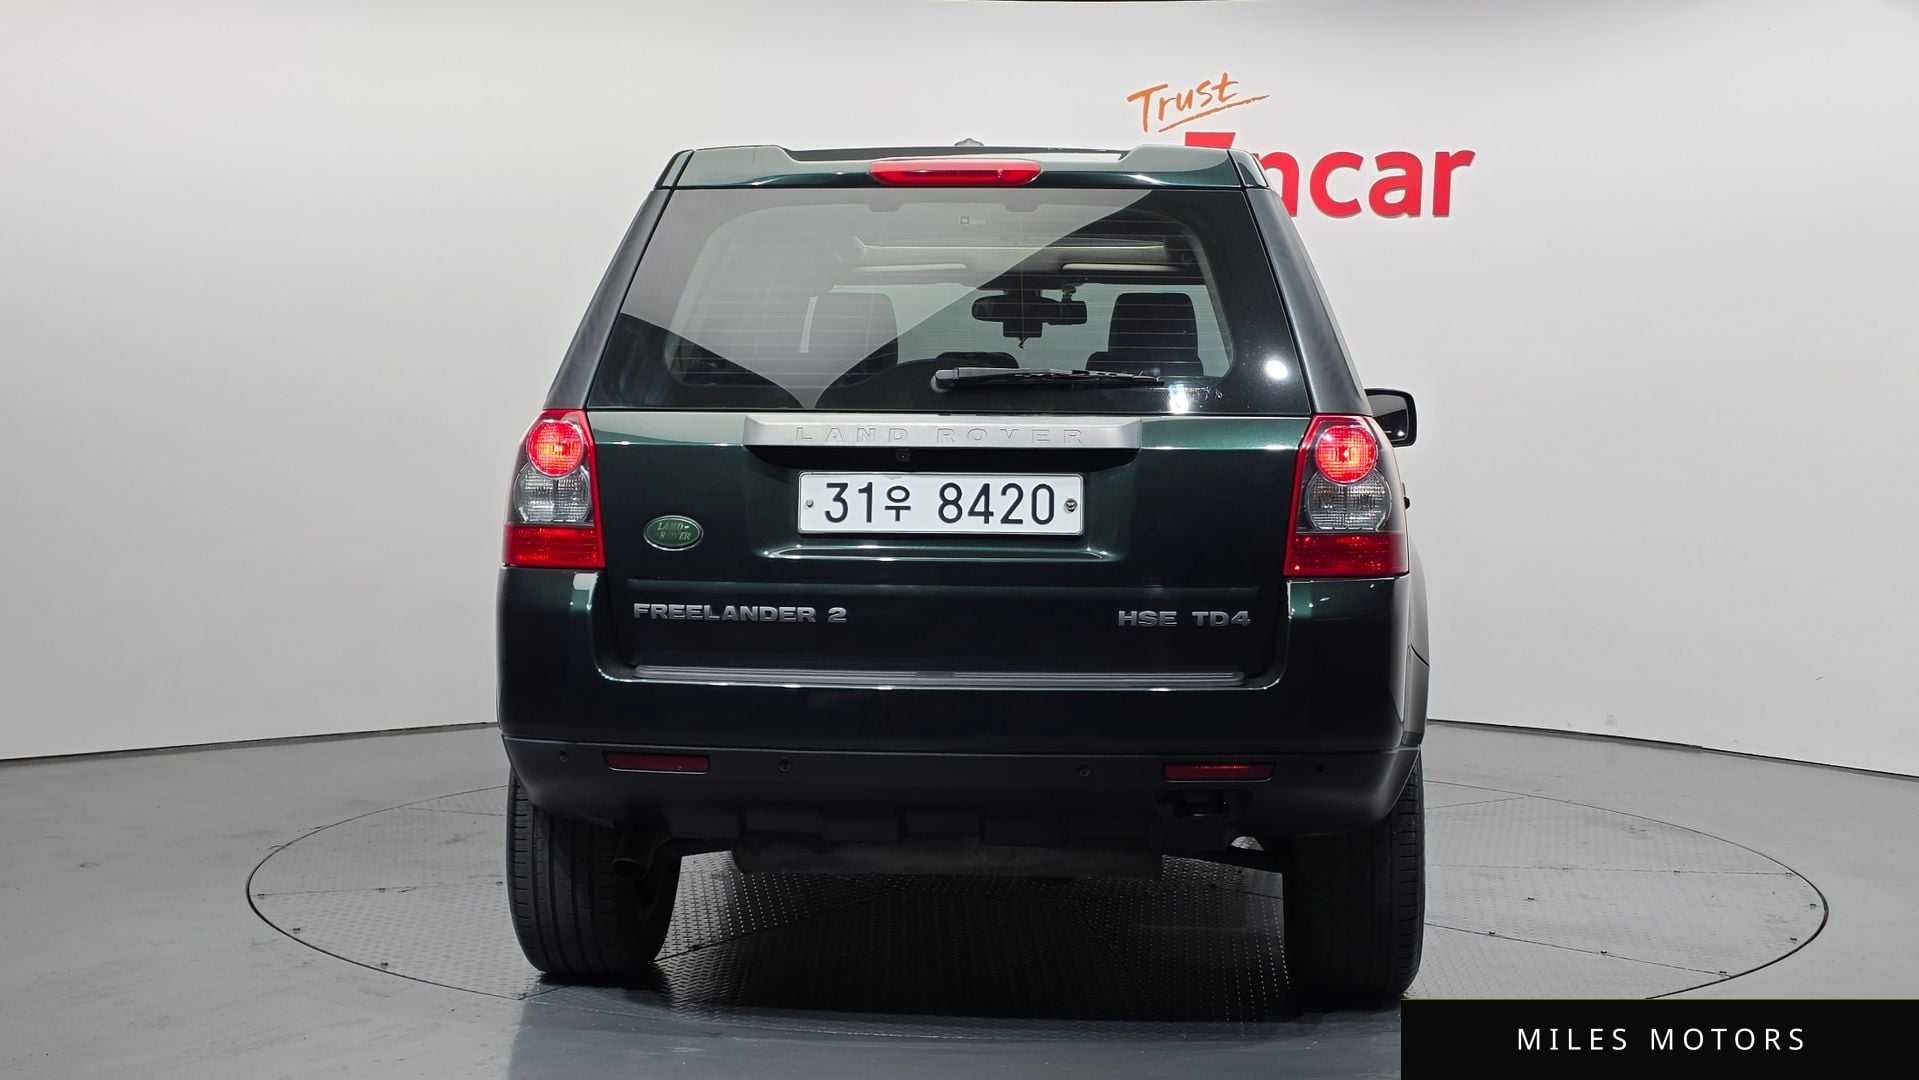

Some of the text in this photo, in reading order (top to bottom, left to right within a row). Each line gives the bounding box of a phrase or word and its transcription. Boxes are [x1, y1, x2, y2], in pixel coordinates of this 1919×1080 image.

[1127, 72, 1239, 133] Trust
[1184, 131, 1476, 218] ncar
[795, 426, 1084, 445] LAND ROVER
[824, 481, 1055, 525] 31우 8420
[633, 603, 847, 624] FREELANDER 2
[1118, 610, 1251, 627] HSE TD4
